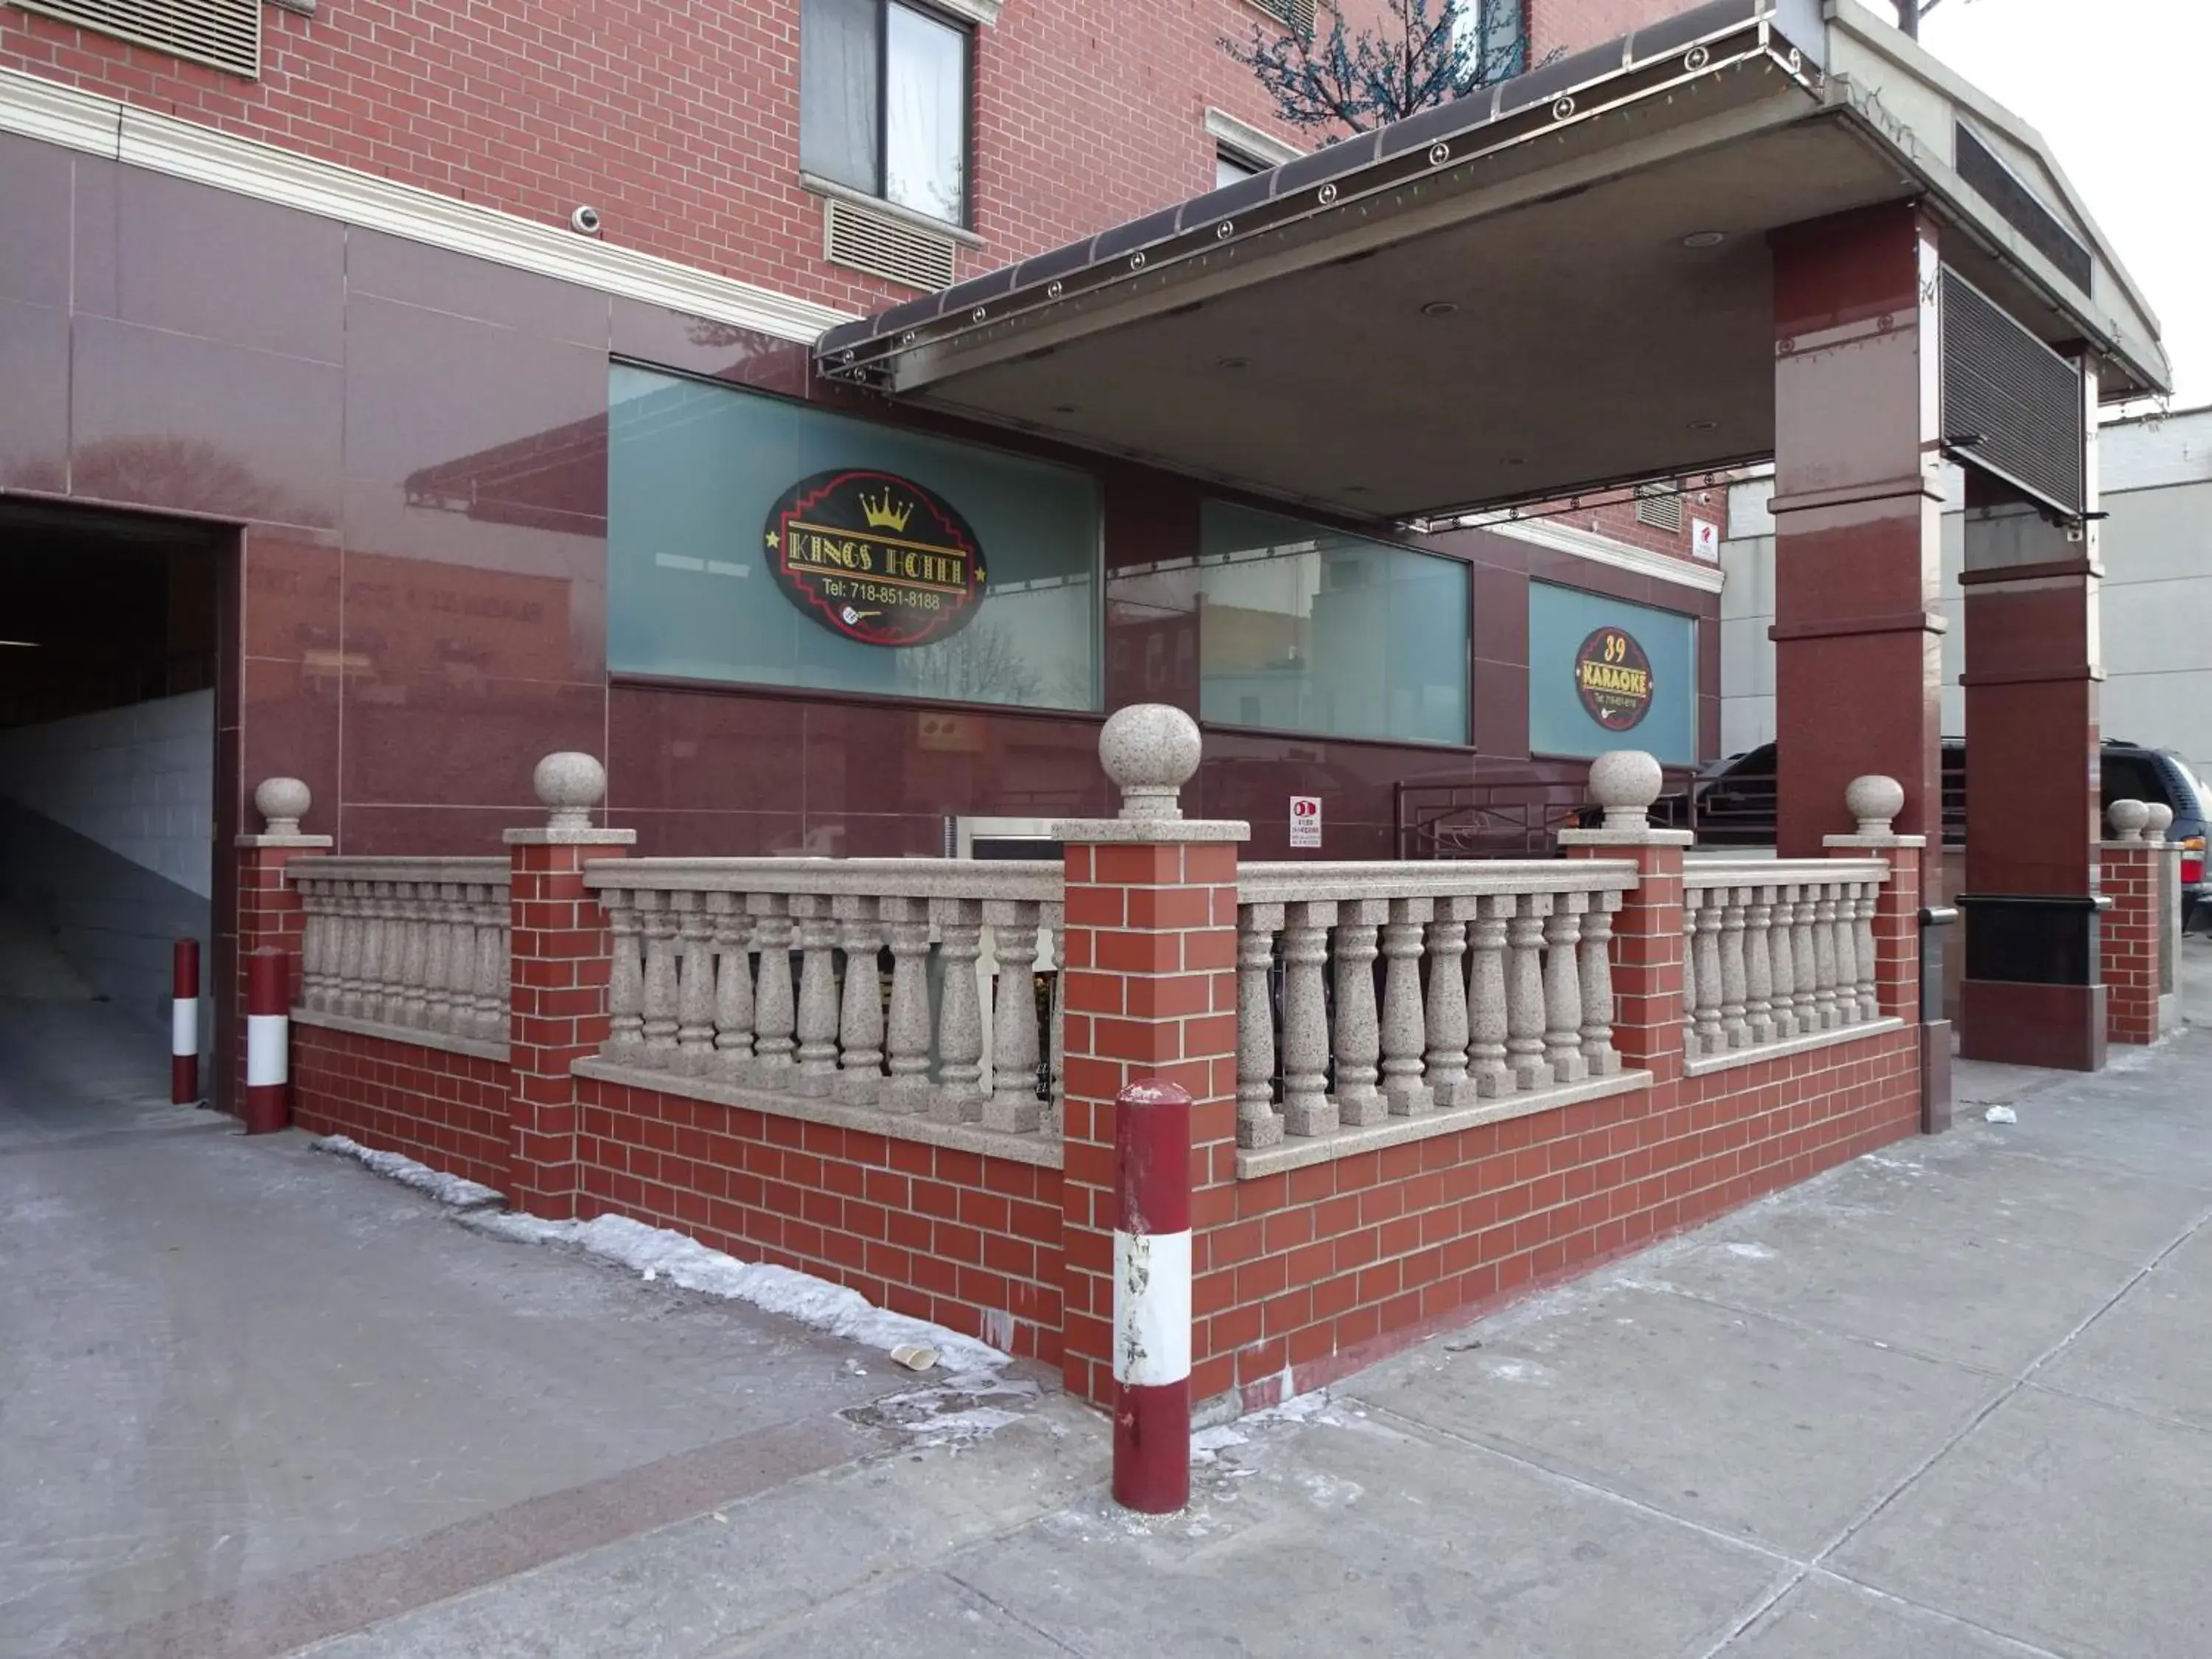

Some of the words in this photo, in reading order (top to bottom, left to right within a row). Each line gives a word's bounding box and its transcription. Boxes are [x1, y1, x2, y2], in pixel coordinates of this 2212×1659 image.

[788, 532, 872, 570] KINGS
[885, 548, 967, 584] HOTEL
[822, 578, 847, 598] Tel:
[850, 582, 940, 611] 718-851-8188
[1604, 635, 1626, 663] 39
[1583, 664, 1646, 694] KARAOKE
